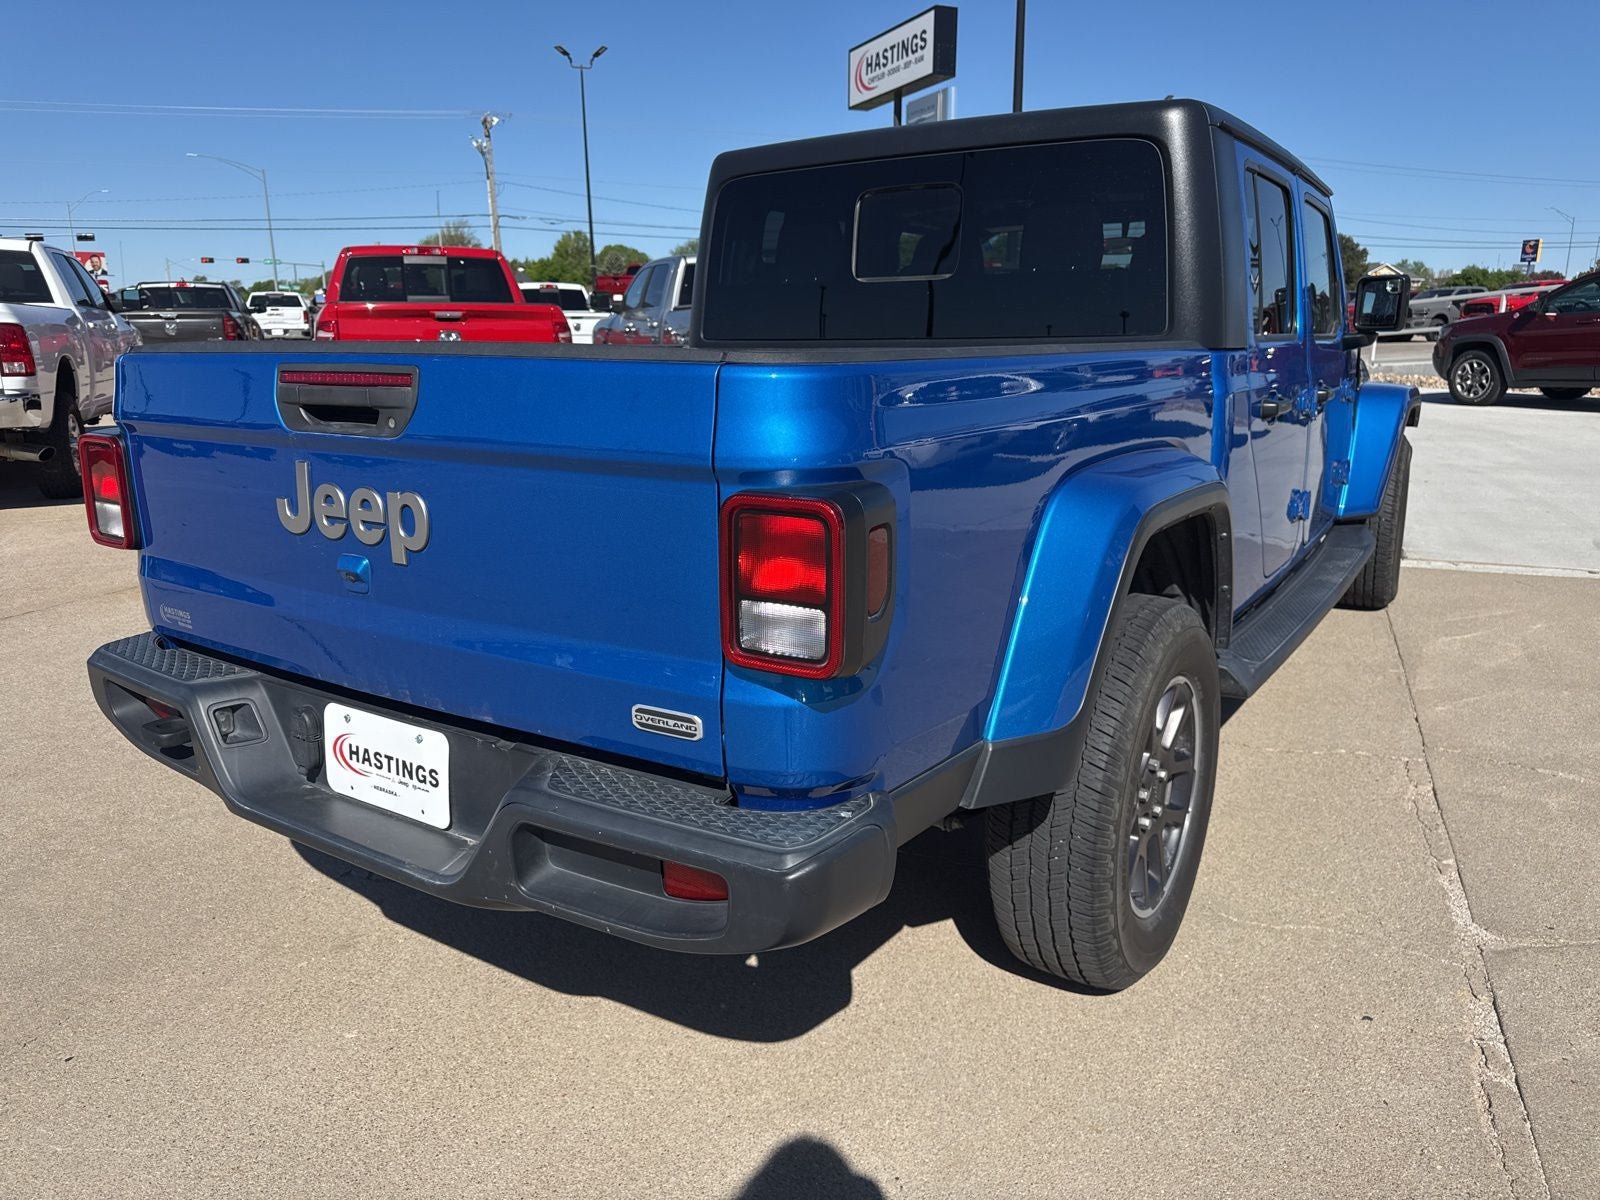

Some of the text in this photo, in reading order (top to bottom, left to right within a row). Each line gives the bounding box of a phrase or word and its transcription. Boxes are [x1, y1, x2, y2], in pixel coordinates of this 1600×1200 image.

[866, 29, 927, 76] HASTINGS
[276, 460, 429, 565] Jeep
[164, 606, 190, 620] HASTINGS
[634, 713, 698, 732] OVERLAND
[348, 743, 440, 788] HASTINGS
[373, 785, 399, 797] NEBRASKA
